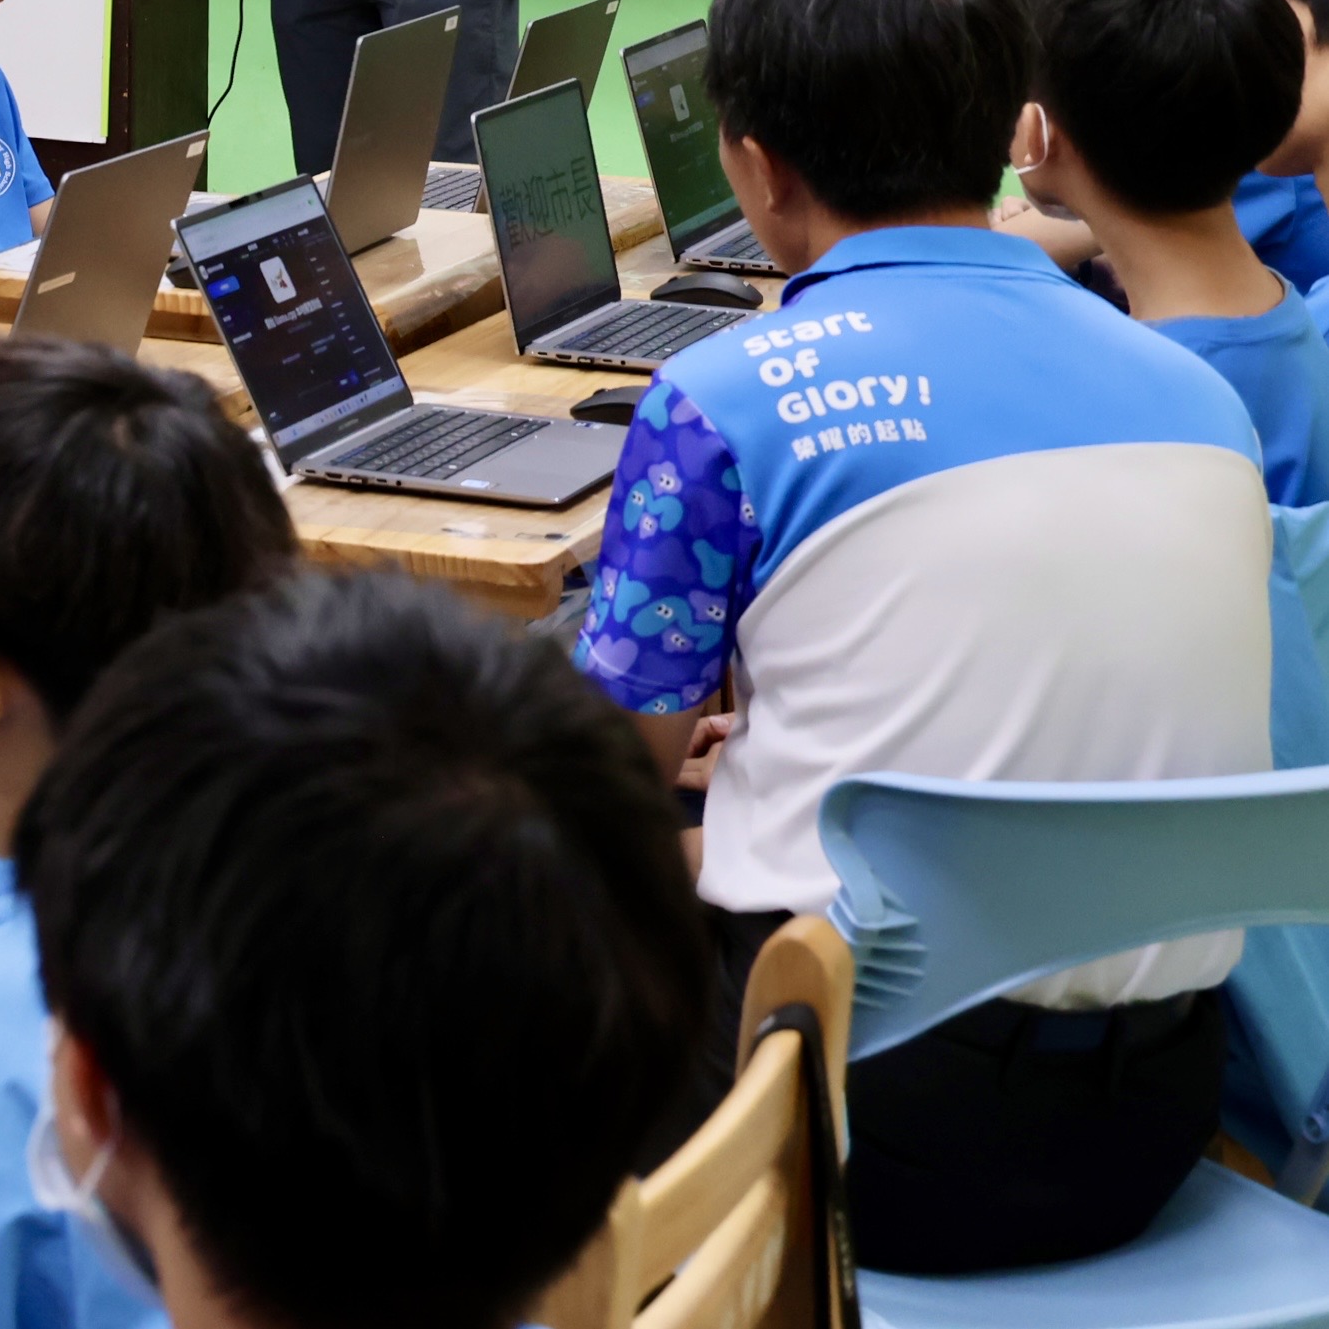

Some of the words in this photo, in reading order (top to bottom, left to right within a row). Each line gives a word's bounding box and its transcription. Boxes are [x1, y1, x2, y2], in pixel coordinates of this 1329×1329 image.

[791, 418, 927, 462] 榮耀的起點
